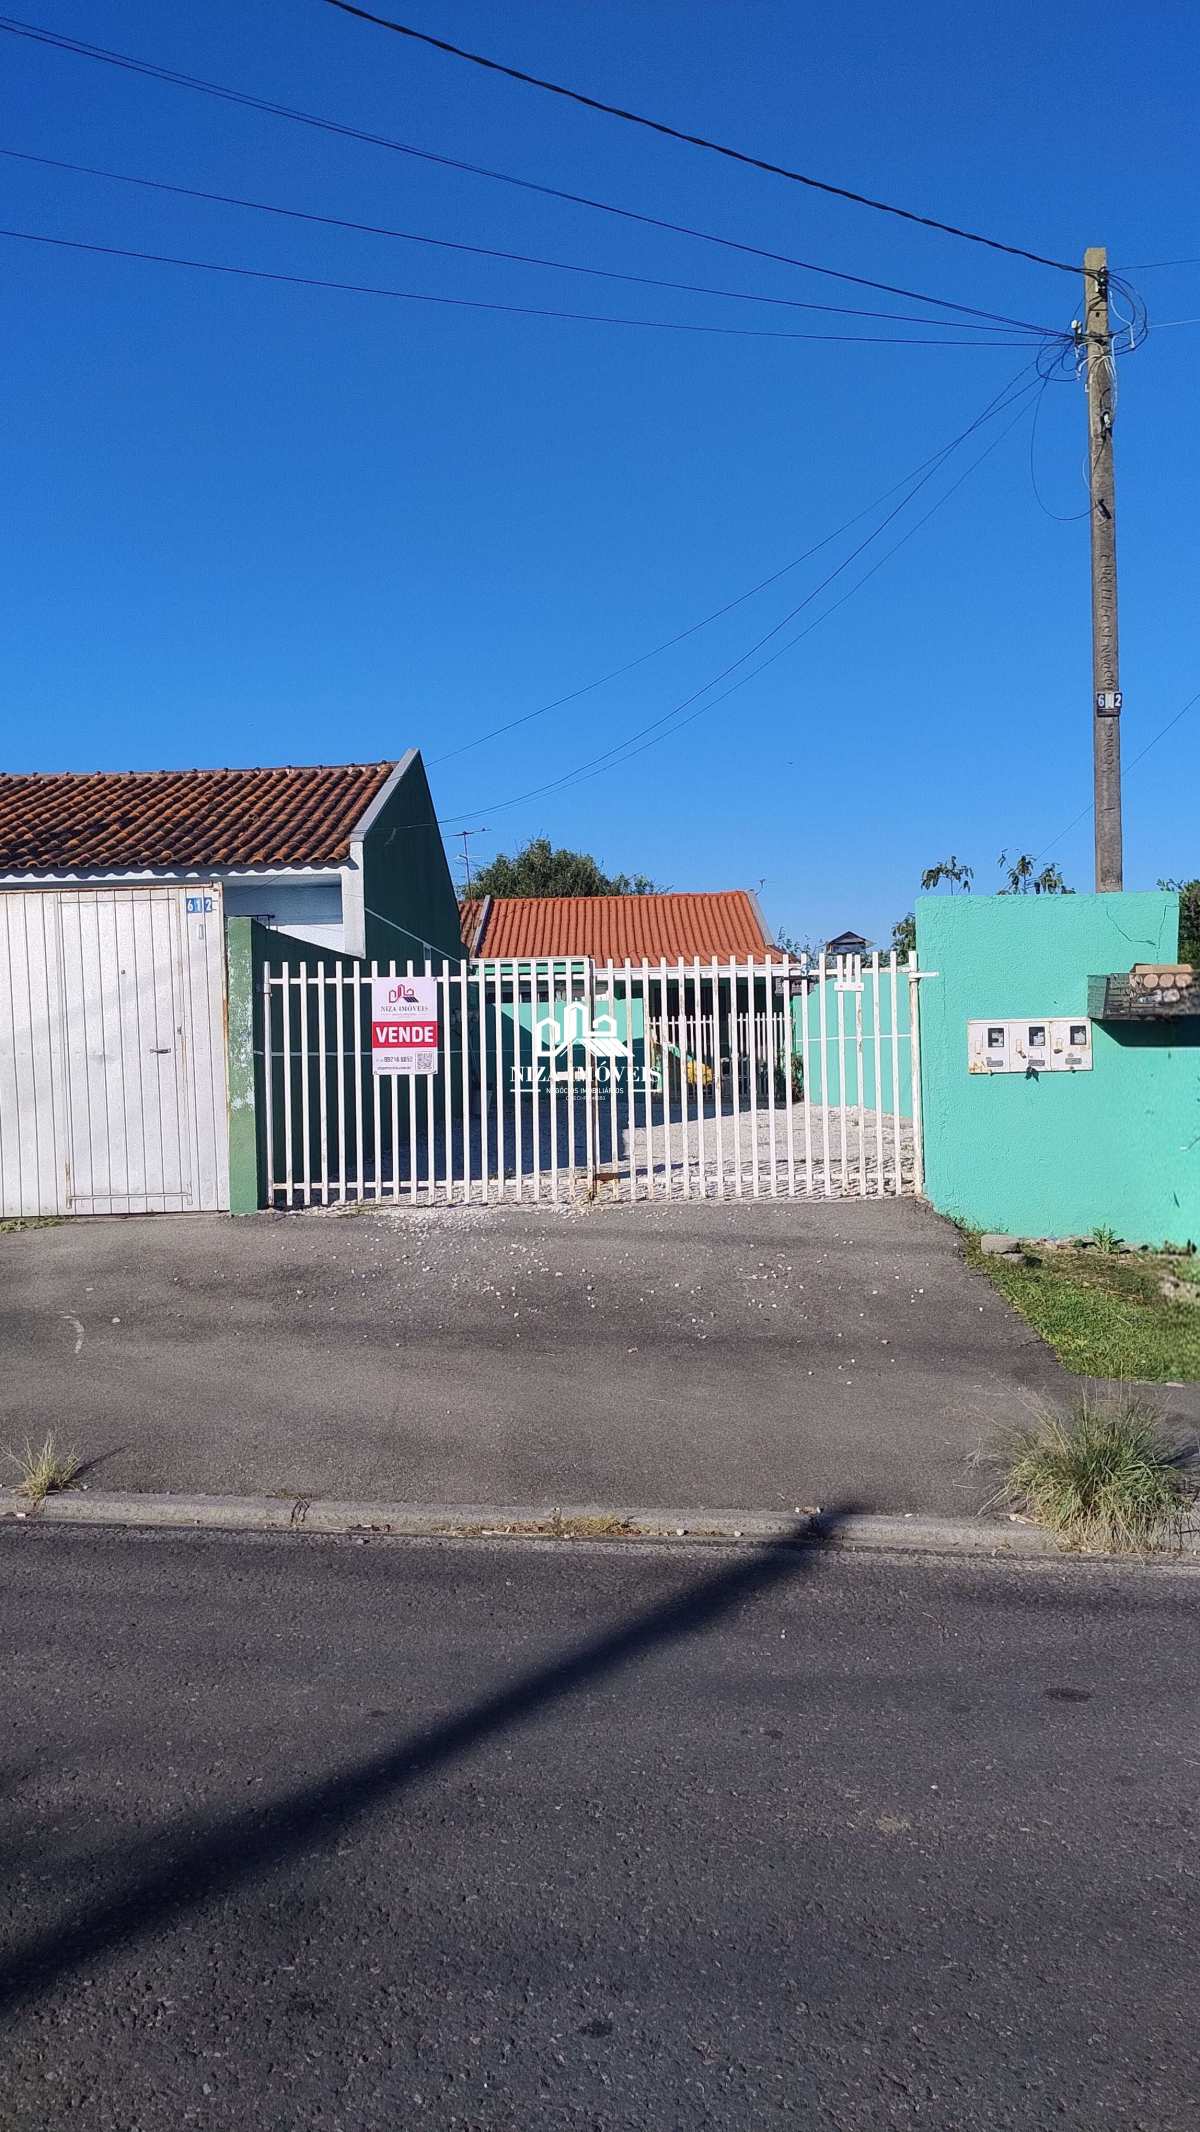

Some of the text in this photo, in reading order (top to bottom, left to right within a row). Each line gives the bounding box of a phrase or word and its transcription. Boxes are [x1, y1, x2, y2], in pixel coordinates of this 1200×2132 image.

[1097, 694, 1122, 708] 62
[187, 898, 212, 912] 612
[375, 1026, 434, 1043] VENDE
